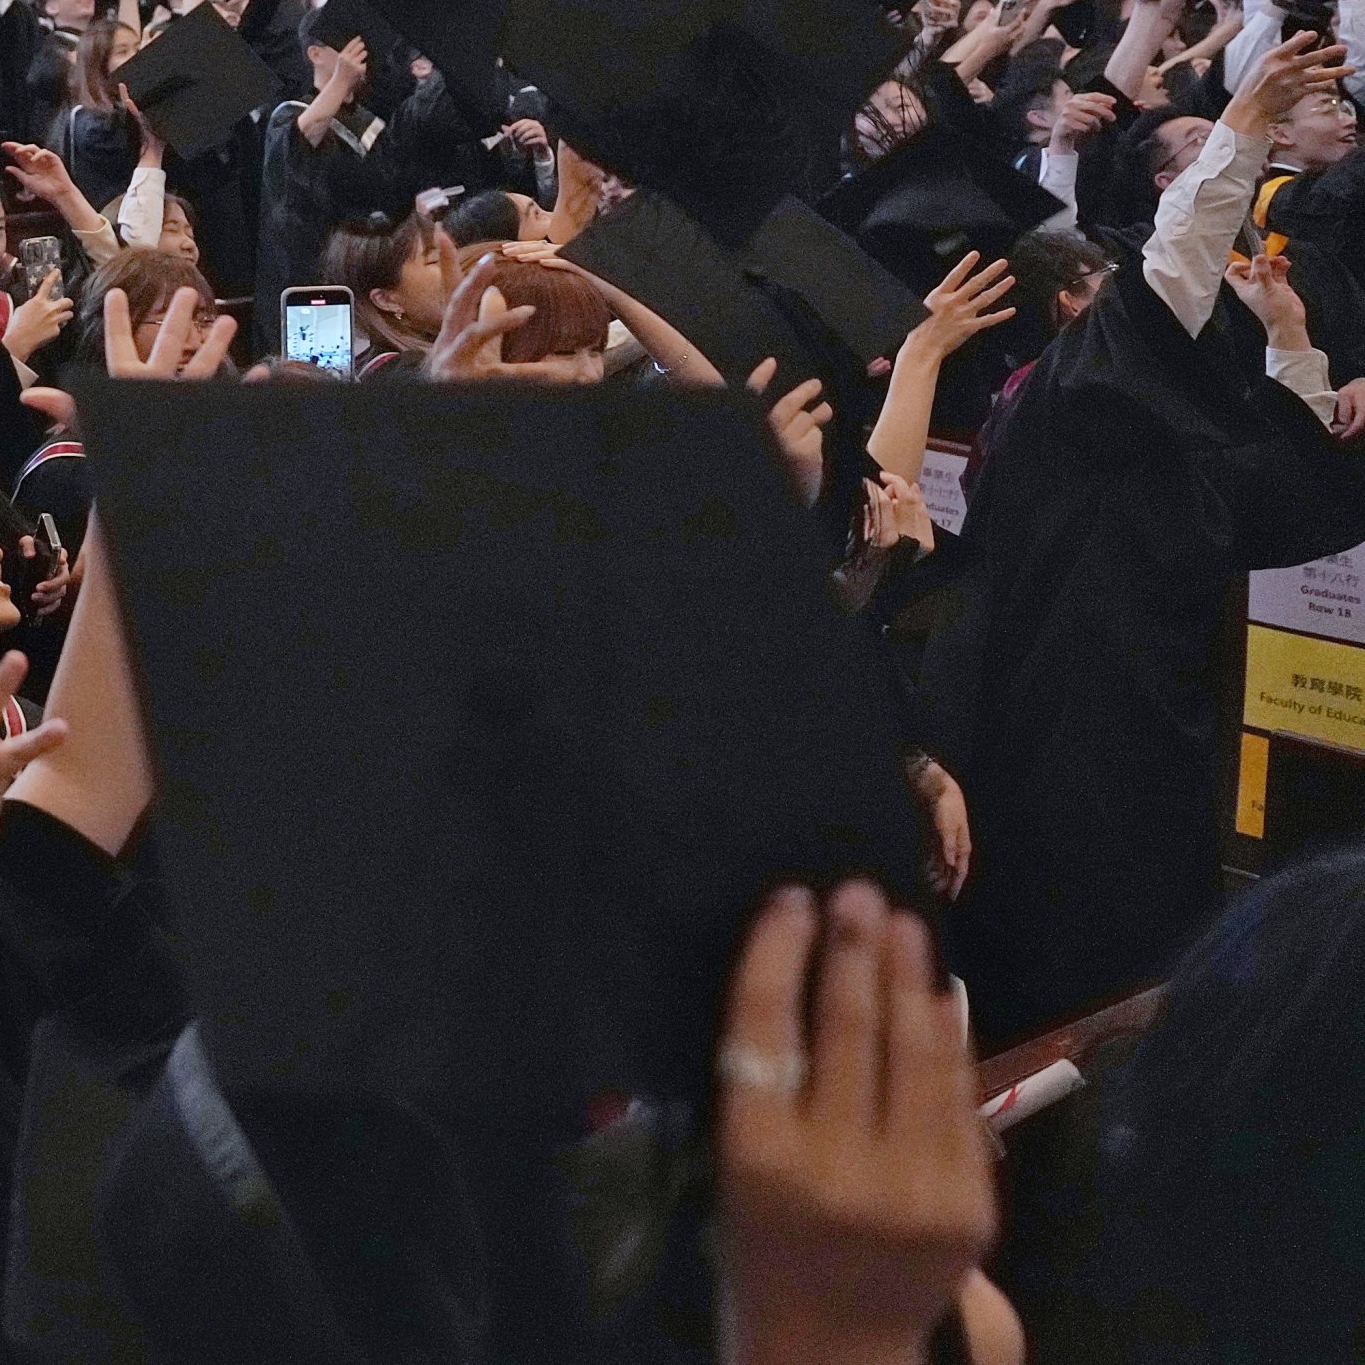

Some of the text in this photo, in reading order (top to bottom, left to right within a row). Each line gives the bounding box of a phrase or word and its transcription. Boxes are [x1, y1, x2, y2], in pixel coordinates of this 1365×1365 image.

[1300, 584, 1361, 605] Graduates
[1308, 601, 1352, 618] Row 18
[1292, 673, 1364, 702] 教育學院
[1259, 691, 1305, 714] Faculty
[1308, 705, 1323, 715] of
